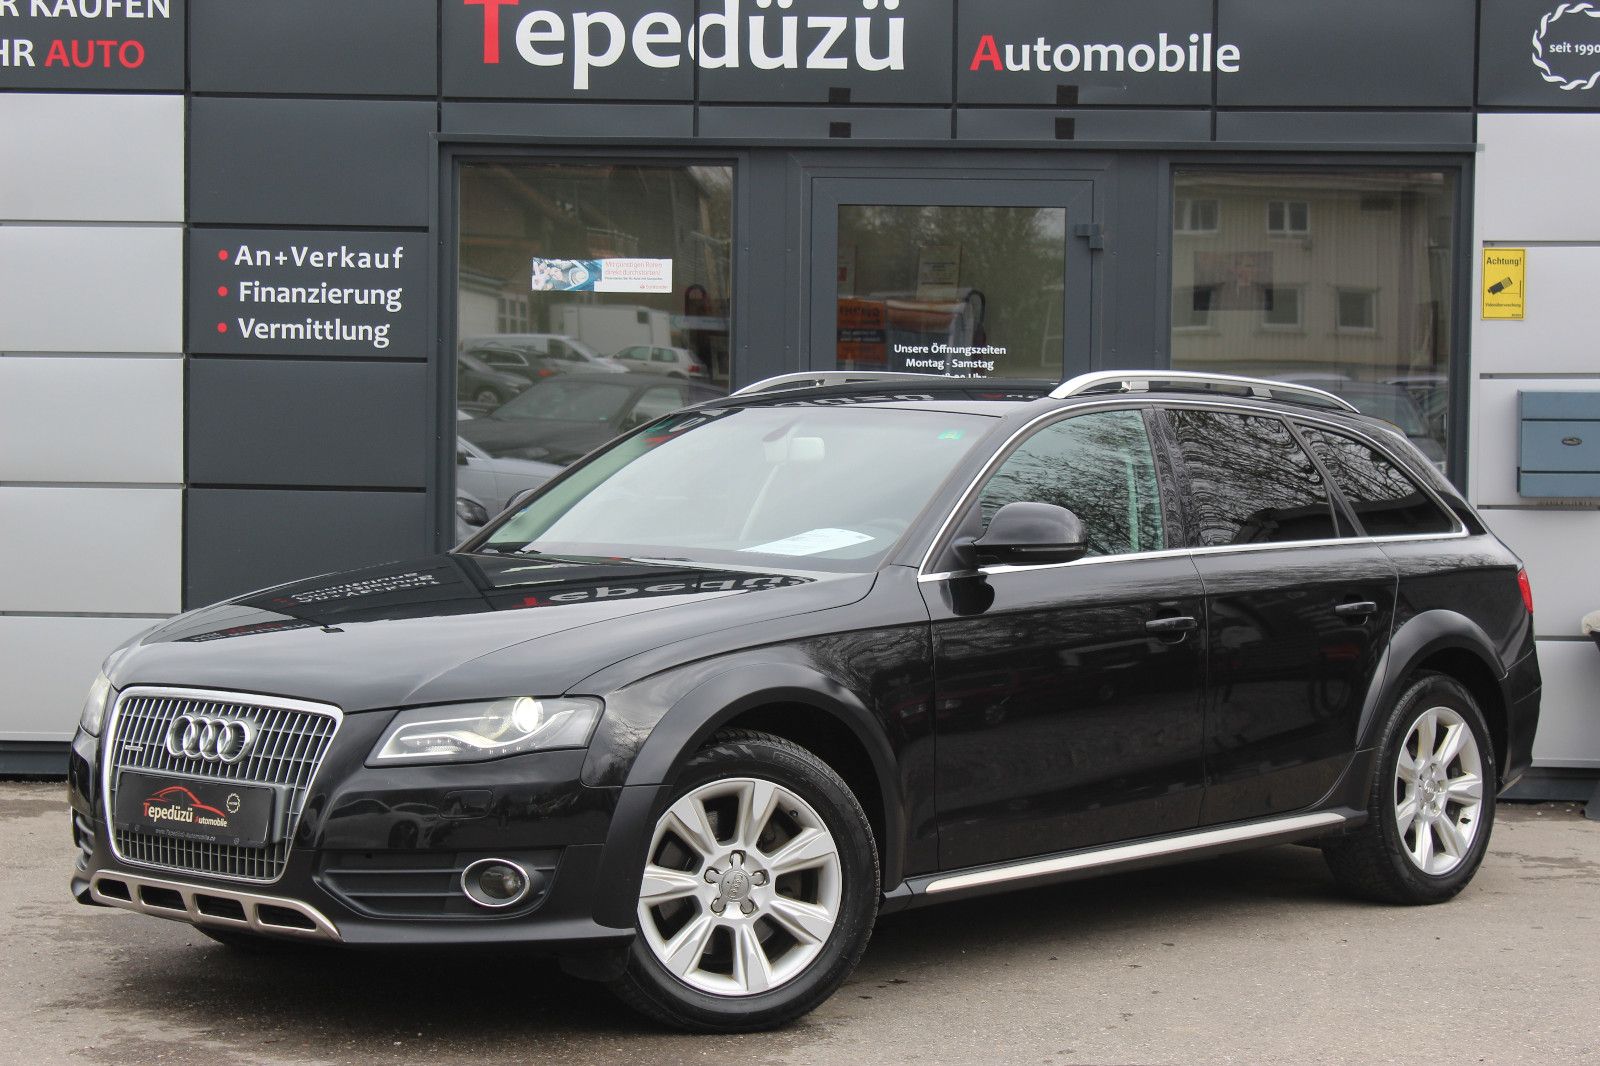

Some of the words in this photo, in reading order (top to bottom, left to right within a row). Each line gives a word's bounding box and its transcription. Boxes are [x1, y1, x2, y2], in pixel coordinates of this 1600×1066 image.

[30, 0, 170, 18] KAUFEN
[44, 39, 145, 69] AUTO
[463, 0, 905, 90] Tepedüzü
[969, 32, 1241, 73] Automobile
[1549, 41, 1572, 53] seit
[1574, 44, 1600, 56] 1990
[234, 245, 404, 269] An+Verkauf
[1486, 257, 1522, 267] Achtung!
[239, 280, 403, 313] Finanzierung
[238, 317, 391, 349] Vermittlung
[893, 344, 929, 354] Unsere
[931, 342, 1007, 357] Öffnungszeiten
[905, 358, 945, 371] Montag
[951, 358, 995, 371] Samstag
[143, 802, 194, 823] Tepedüzü
